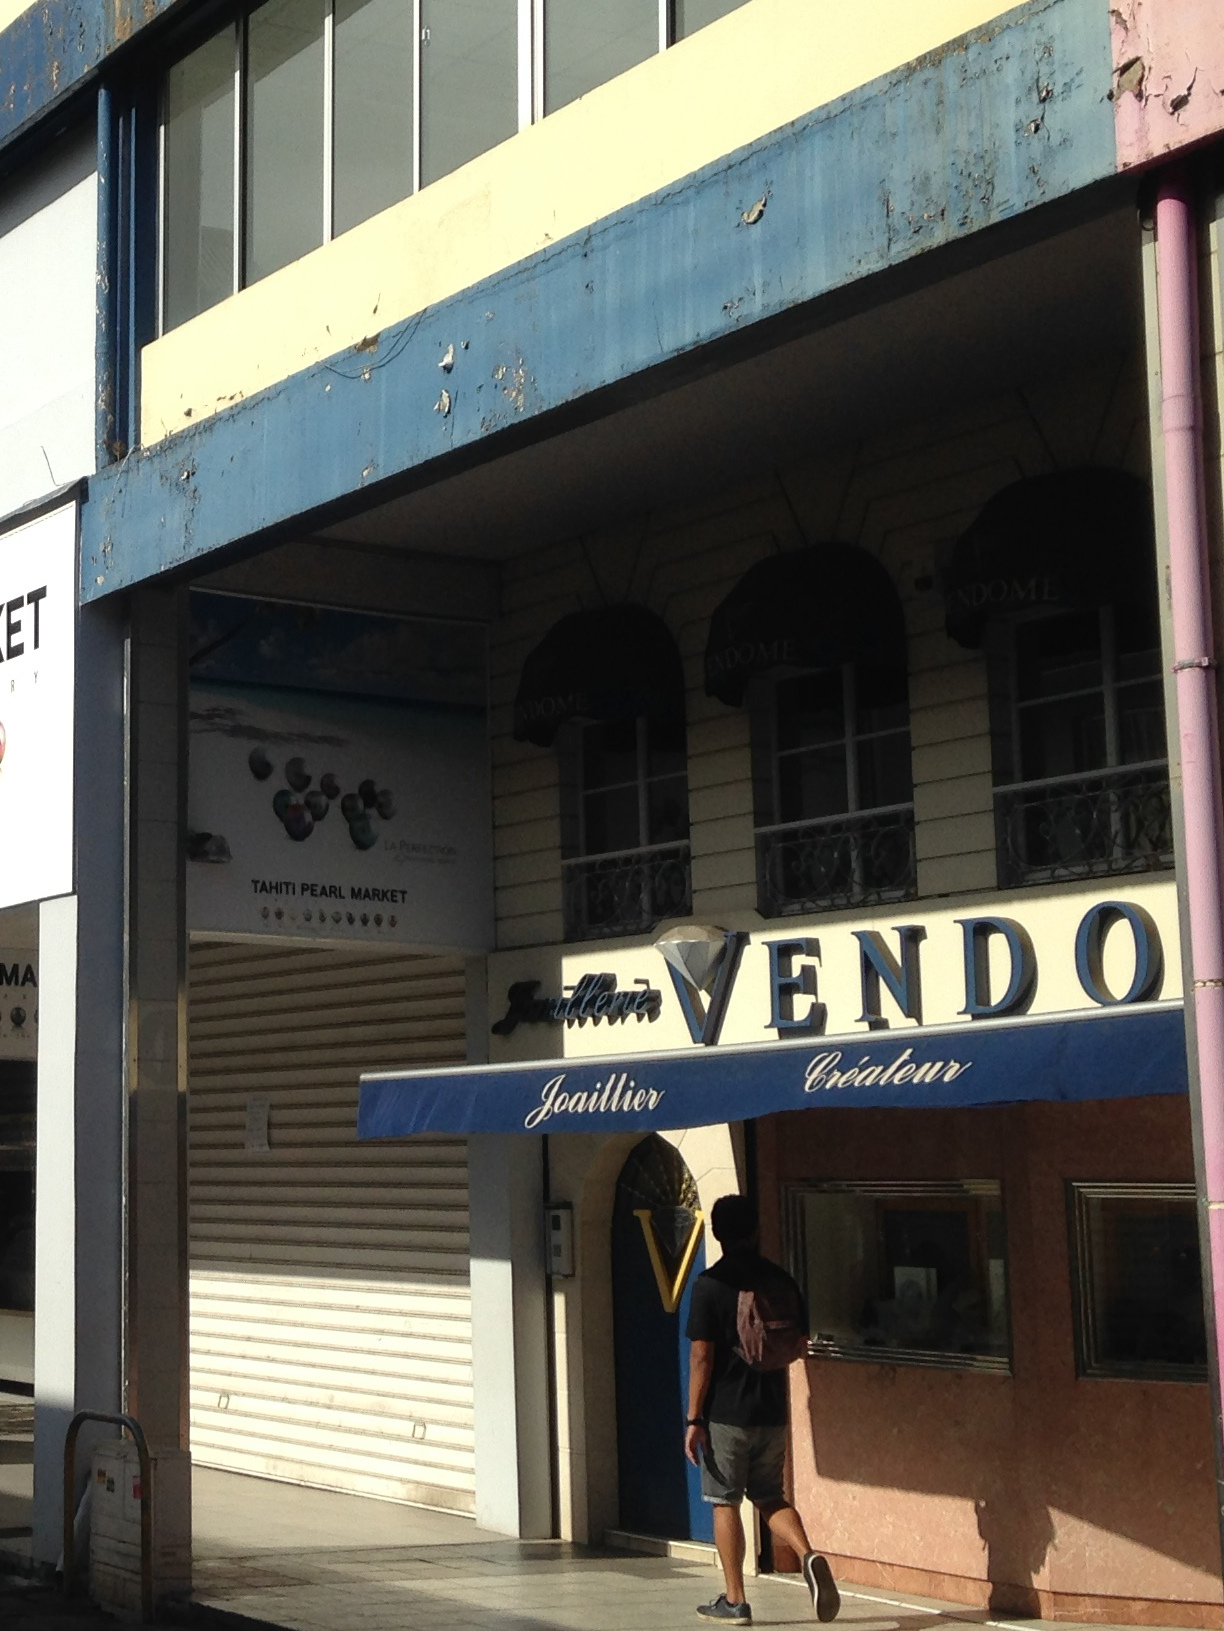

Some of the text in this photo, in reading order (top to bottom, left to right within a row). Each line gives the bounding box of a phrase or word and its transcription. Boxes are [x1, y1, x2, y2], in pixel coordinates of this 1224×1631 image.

[251, 879, 408, 903] TAHITI PEARL MARKET
[524, 1047, 973, 1128] Joaillier Créateur
